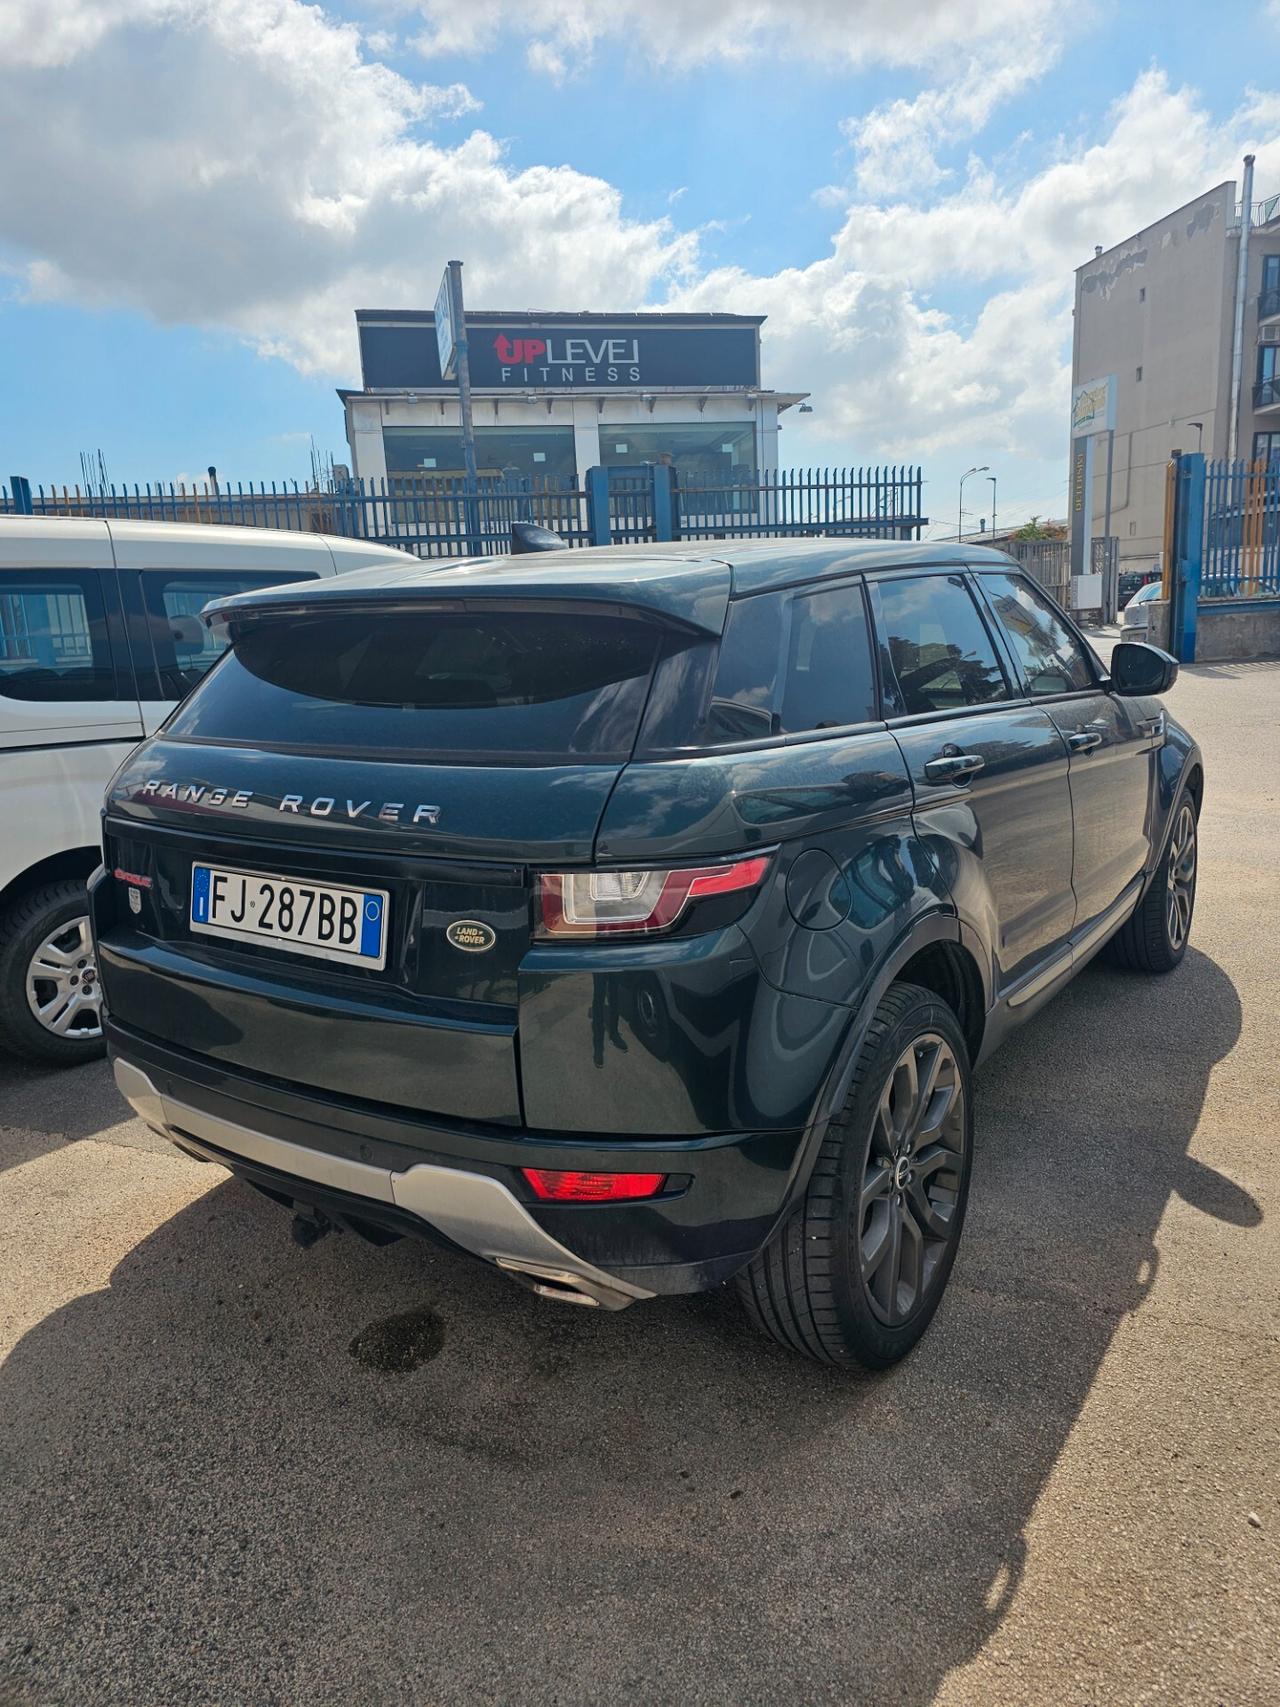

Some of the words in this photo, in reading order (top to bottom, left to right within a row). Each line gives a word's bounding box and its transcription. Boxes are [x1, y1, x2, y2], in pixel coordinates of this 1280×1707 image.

[501, 367, 640, 382] FITNESS
[141, 779, 253, 808] RANGE
[279, 794, 441, 825] ROVER
[456, 927, 478, 936] LAND
[458, 934, 485, 945] ROVER
